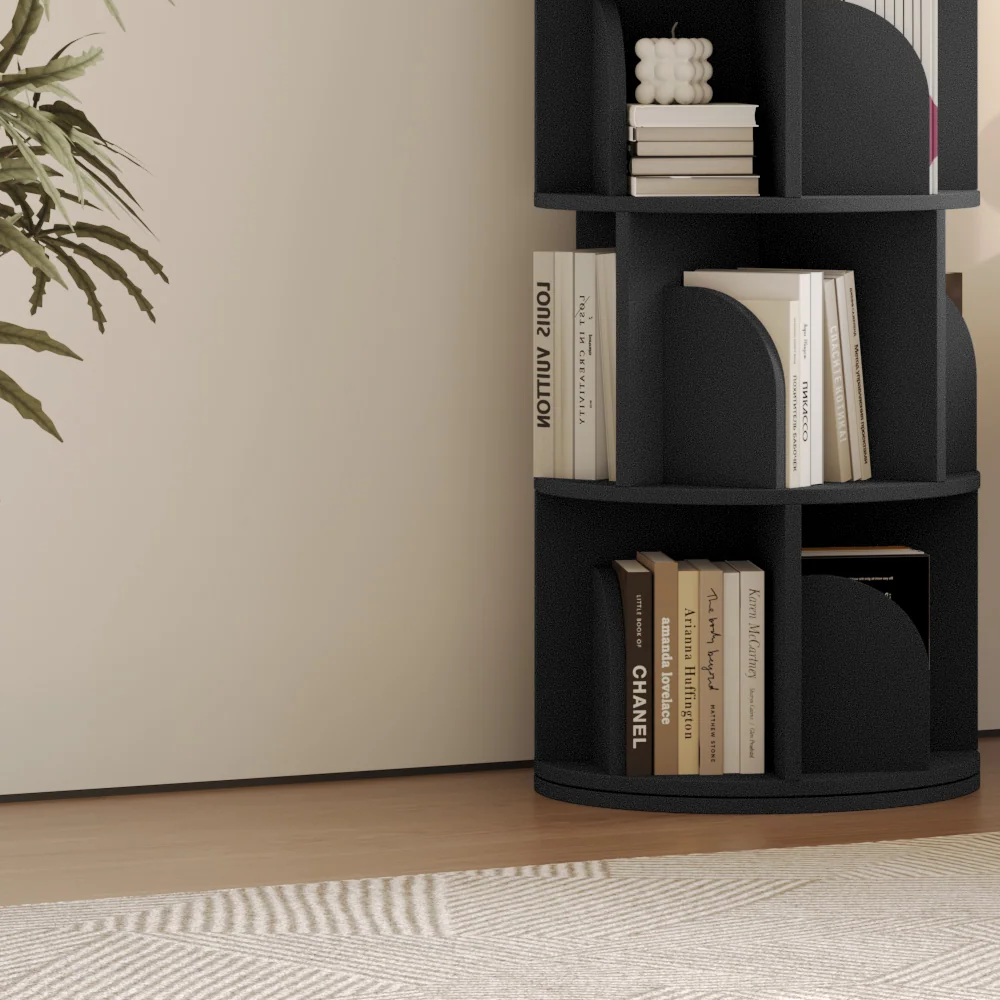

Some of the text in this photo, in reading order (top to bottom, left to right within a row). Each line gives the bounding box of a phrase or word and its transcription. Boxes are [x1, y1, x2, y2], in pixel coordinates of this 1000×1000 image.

[830, 325, 848, 444] СПАСИТЕ КОТИКА!
[636, 638, 642, 648] OF
[661, 616, 673, 725] amanda lovelace
[681, 608, 696, 740] Arianna Huffington
[701, 588, 722, 691] The body beyond
[744, 588, 760, 680] Karen McCartney
[632, 664, 648, 750] CHANEL
